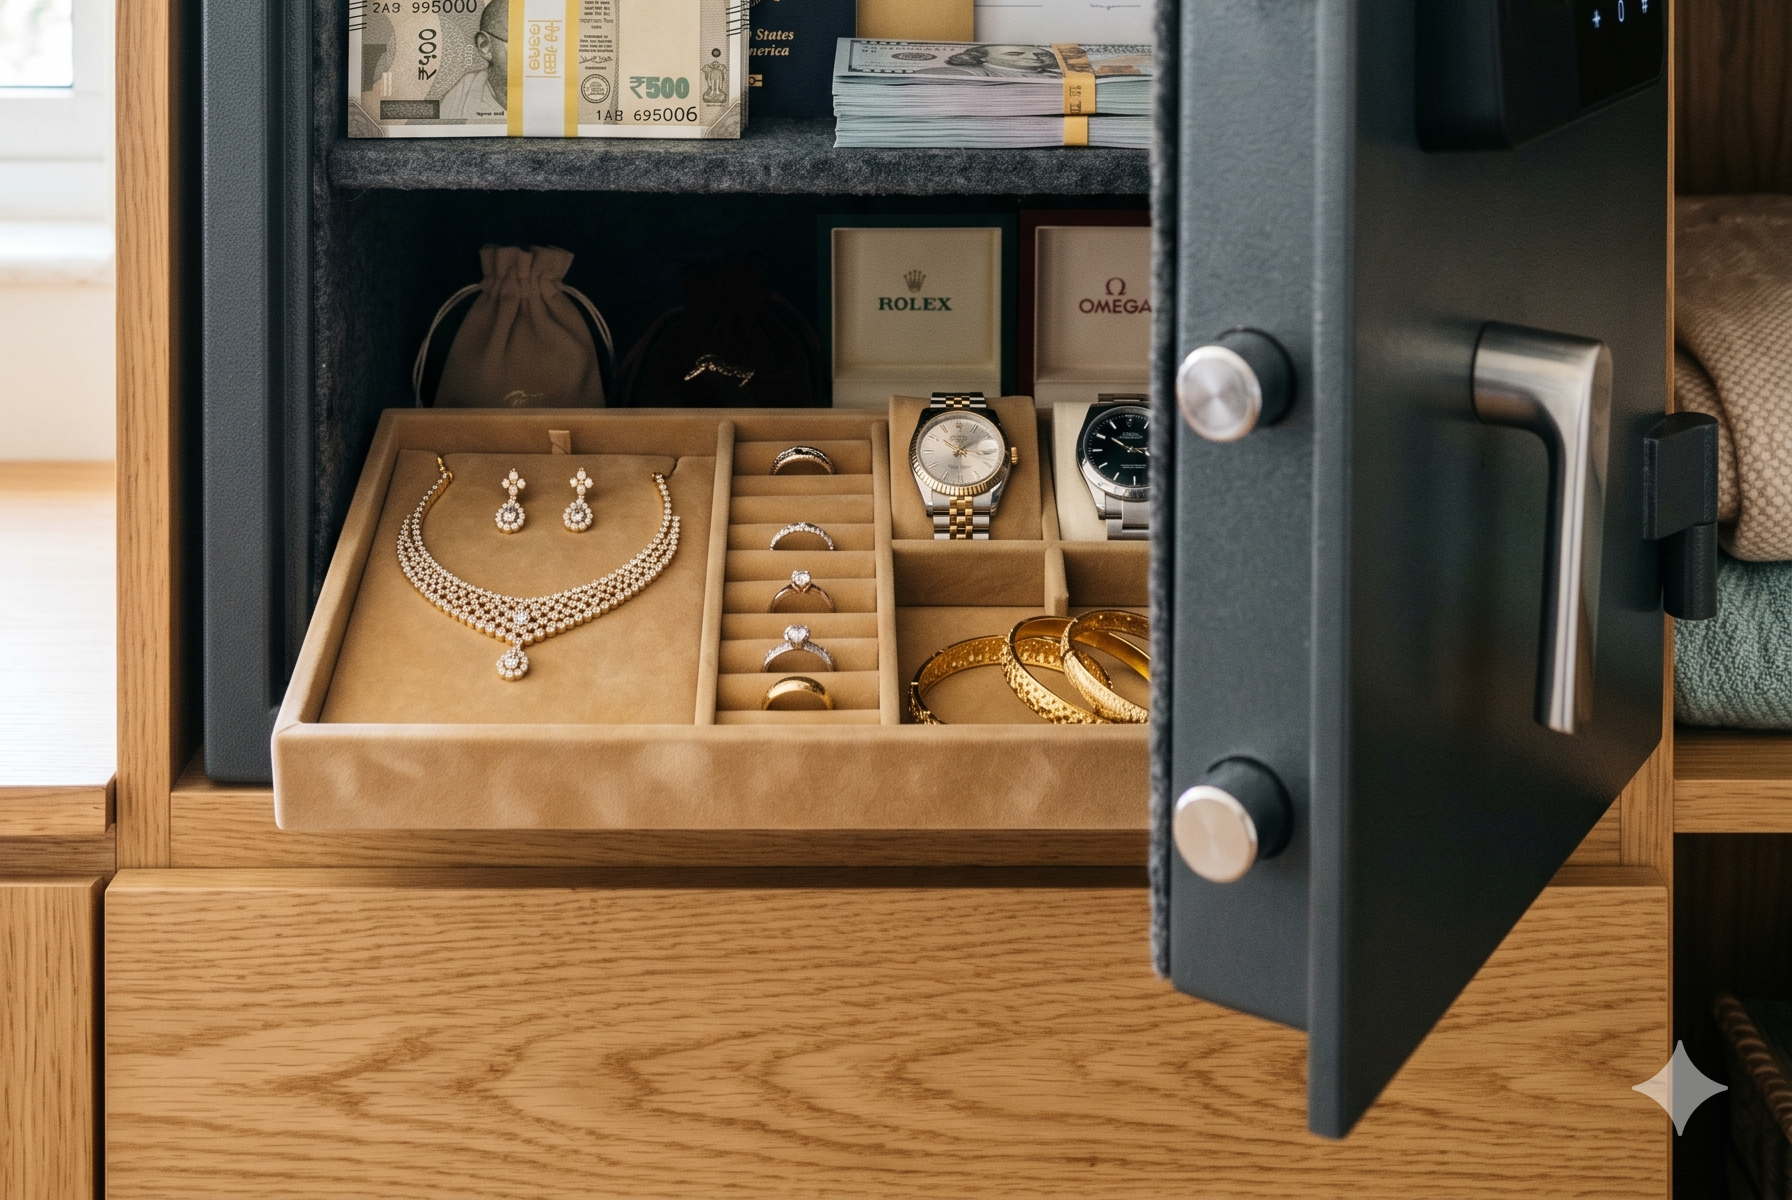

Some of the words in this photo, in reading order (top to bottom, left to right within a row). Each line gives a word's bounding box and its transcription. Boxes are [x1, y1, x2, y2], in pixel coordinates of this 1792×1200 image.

[1617, 0, 1625, 23] 0
[755, 28, 794, 41] States
[629, 76, 690, 100] ₹500
[633, 106, 698, 122] 695006
[878, 296, 952, 311] ROLEX
[1078, 298, 1152, 315] OMEGA
